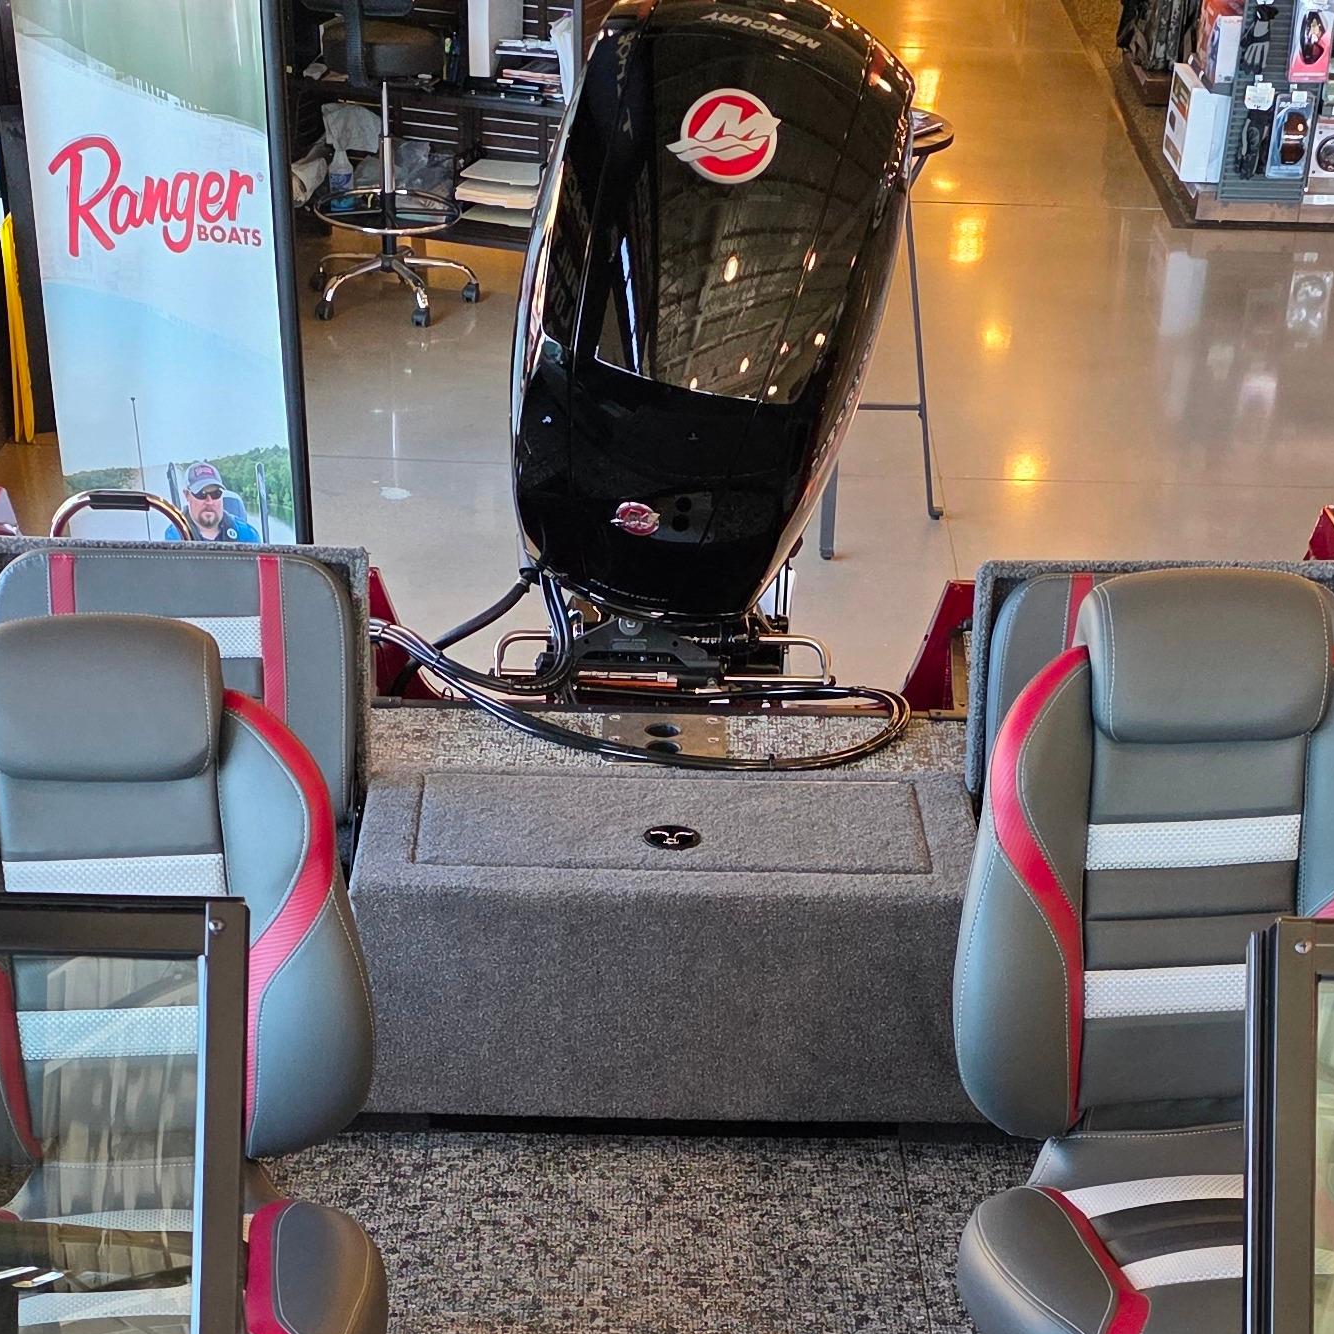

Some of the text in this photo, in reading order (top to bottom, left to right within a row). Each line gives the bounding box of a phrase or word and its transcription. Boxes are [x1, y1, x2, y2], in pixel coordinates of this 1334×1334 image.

[700, 12, 823, 51] MERCURY
[48, 134, 254, 258] Ranger
[197, 223, 262, 247] BOATS
